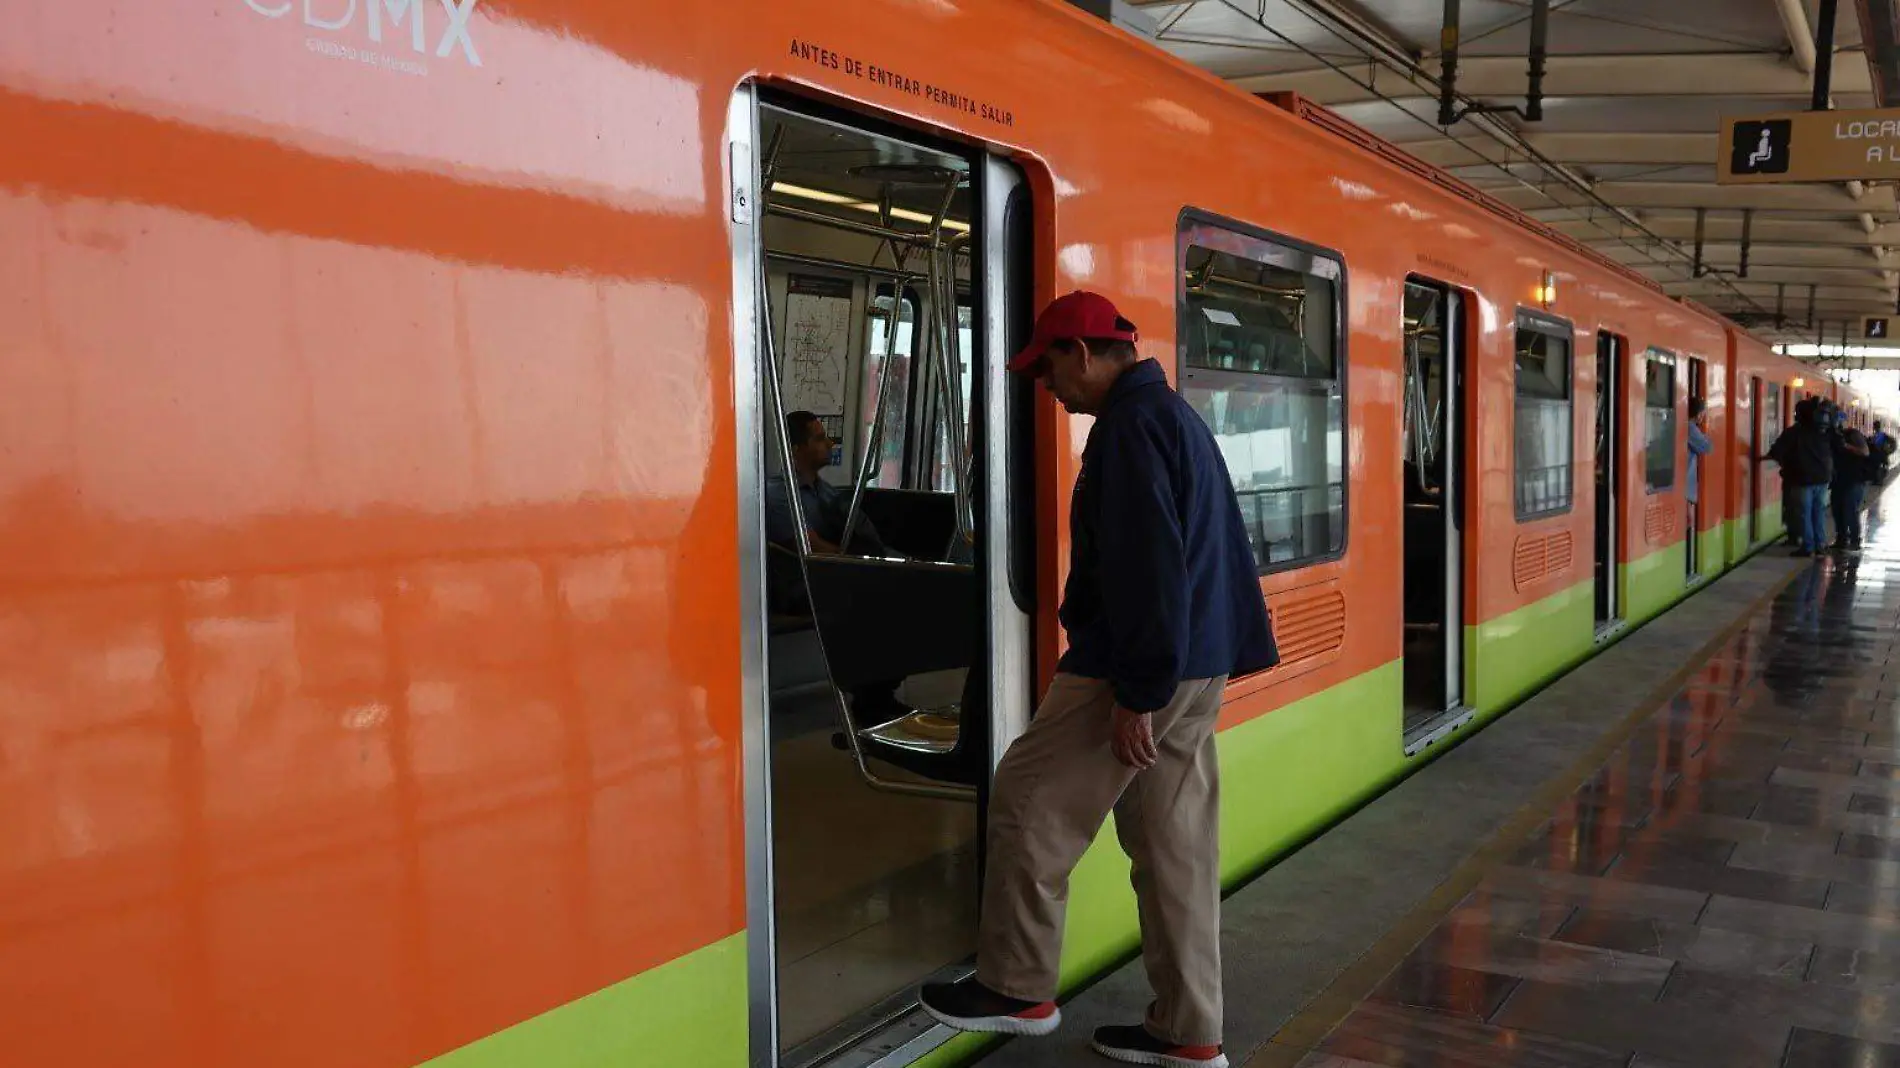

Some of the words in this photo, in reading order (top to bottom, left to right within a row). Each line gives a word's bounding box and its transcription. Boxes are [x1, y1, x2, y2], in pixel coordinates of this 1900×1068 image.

[361, 50, 377, 64] DE
[790, 39, 839, 69] ANTES
[844, 57, 863, 78] DE
[868, 65, 920, 95] ENTRAR
[925, 85, 977, 115] PERMITA
[981, 103, 1013, 126] SALIR
[1835, 120, 1900, 139] LOCA
[1866, 145, 1883, 163] A
